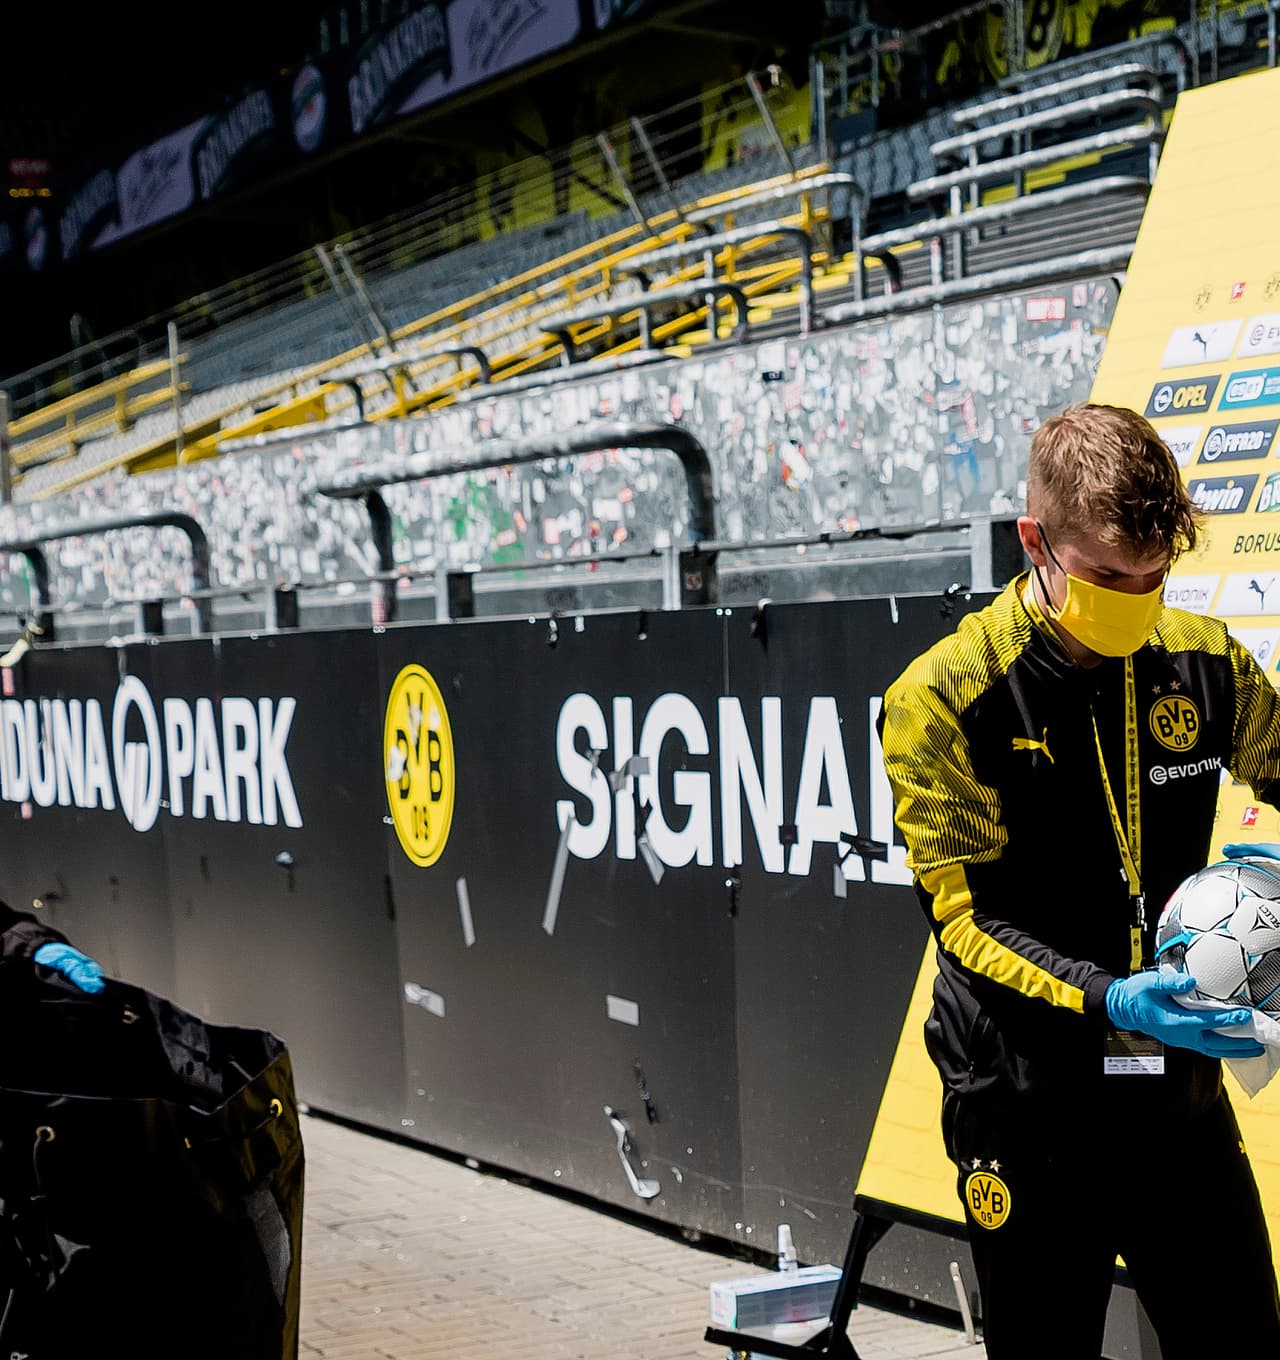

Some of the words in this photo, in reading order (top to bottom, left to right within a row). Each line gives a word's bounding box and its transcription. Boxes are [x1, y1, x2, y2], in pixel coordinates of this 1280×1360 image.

[1173, 384, 1207, 409] OPEL
[1166, 587, 1209, 603] EVONIK
[1156, 701, 1198, 739] BVB
[1174, 732, 1189, 746] 09
[163, 697, 303, 828] PARK
[1168, 756, 1222, 779] EVONIK
[971, 1179, 1005, 1215] BVB
